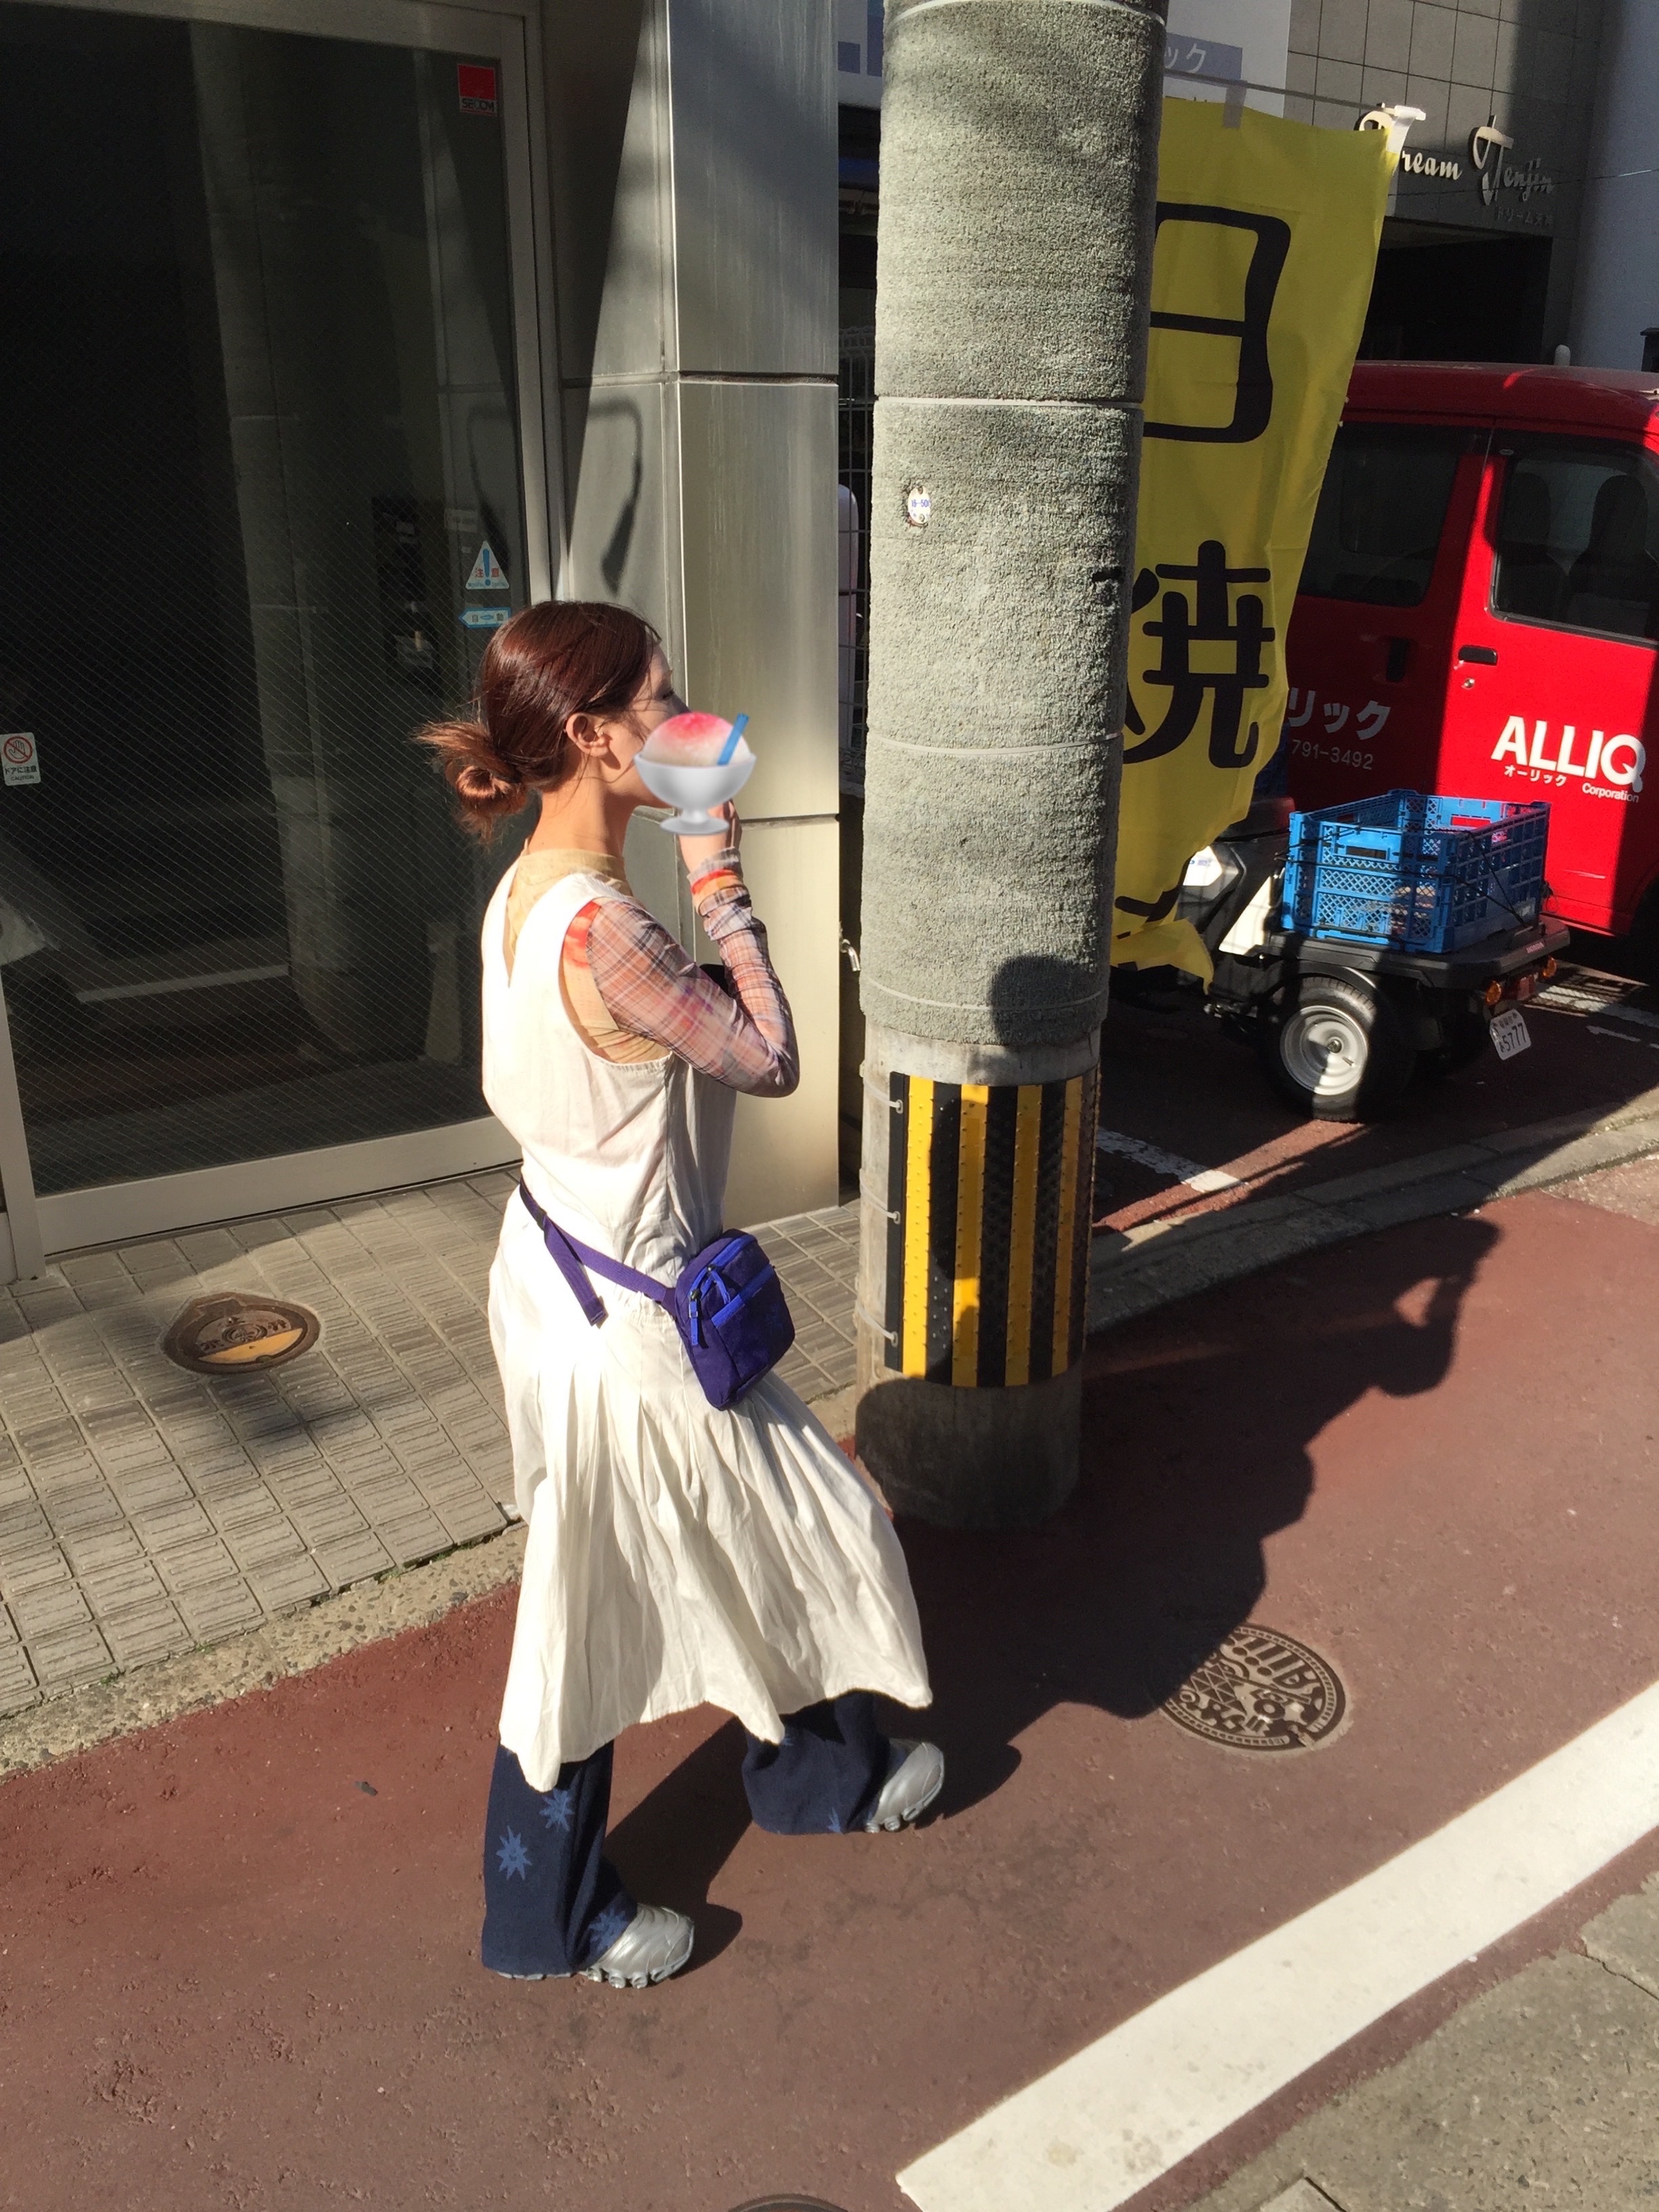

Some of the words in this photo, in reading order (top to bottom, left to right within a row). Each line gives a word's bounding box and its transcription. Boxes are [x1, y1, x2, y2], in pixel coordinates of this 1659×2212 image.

[1292, 739, 1374, 771] 791-3492
[1491, 716, 1646, 793] ALLIQ
[1504, 764, 1567, 787] オーリック
[1582, 782, 1639, 804] Corporation
